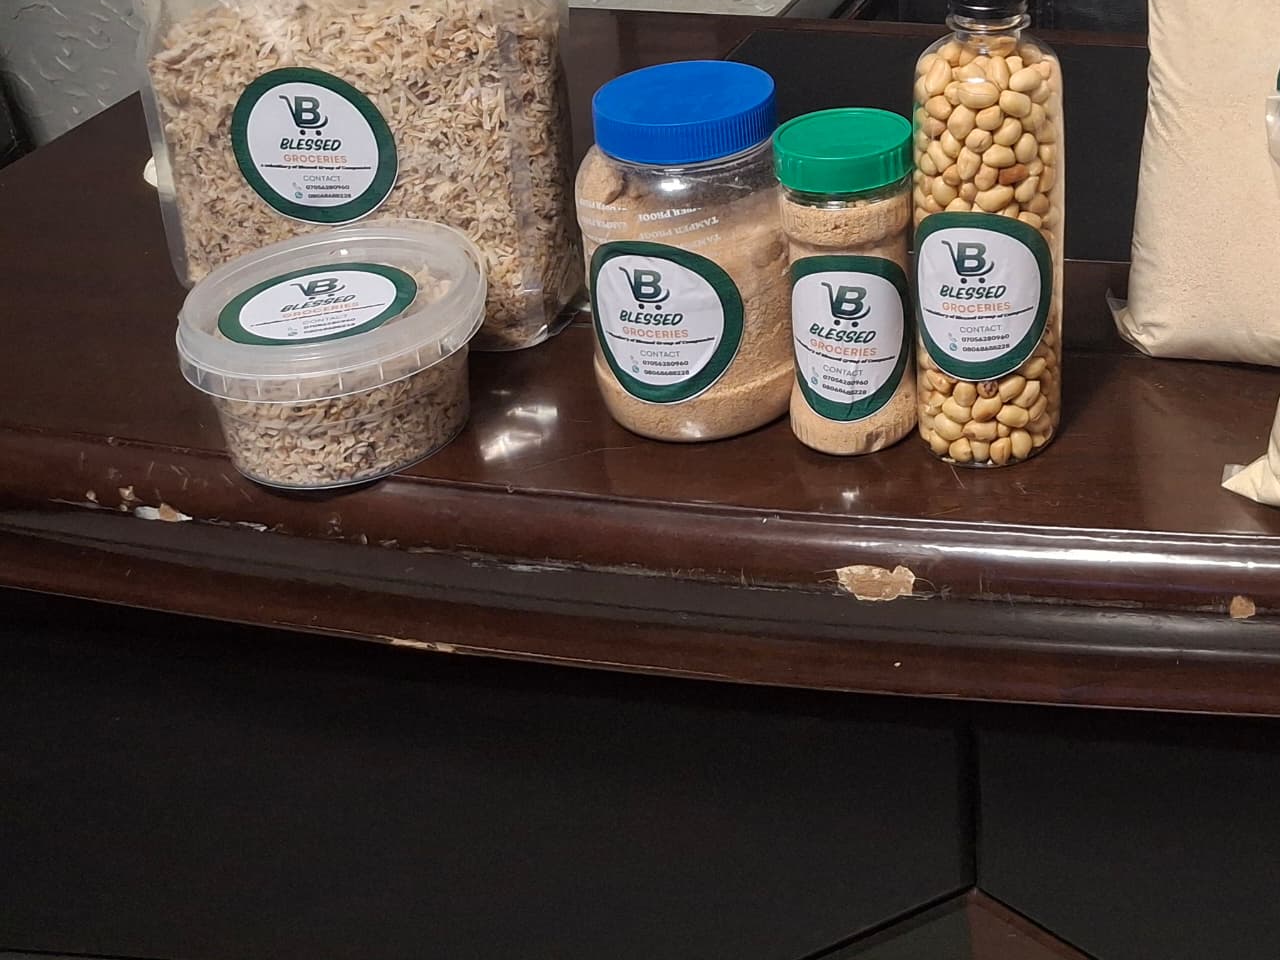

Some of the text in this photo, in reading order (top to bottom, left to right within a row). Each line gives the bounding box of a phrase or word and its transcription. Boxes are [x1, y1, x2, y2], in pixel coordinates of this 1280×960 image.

[279, 138, 342, 151] BLESSED
[283, 154, 348, 164] GROCERIES
[939, 285, 1007, 300] BLESSED
[280, 294, 356, 313] BLESSED
[942, 301, 1011, 313] GROCERIES
[620, 310, 684, 326] BLESSED
[622, 326, 689, 338] GROCERIES
[809, 323, 877, 344] BLESSED
[959, 325, 1002, 334] CONTACT
[639, 350, 681, 358] CONTACT
[809, 338, 878, 357] GROCERIES
[823, 364, 864, 377] CONTACT
